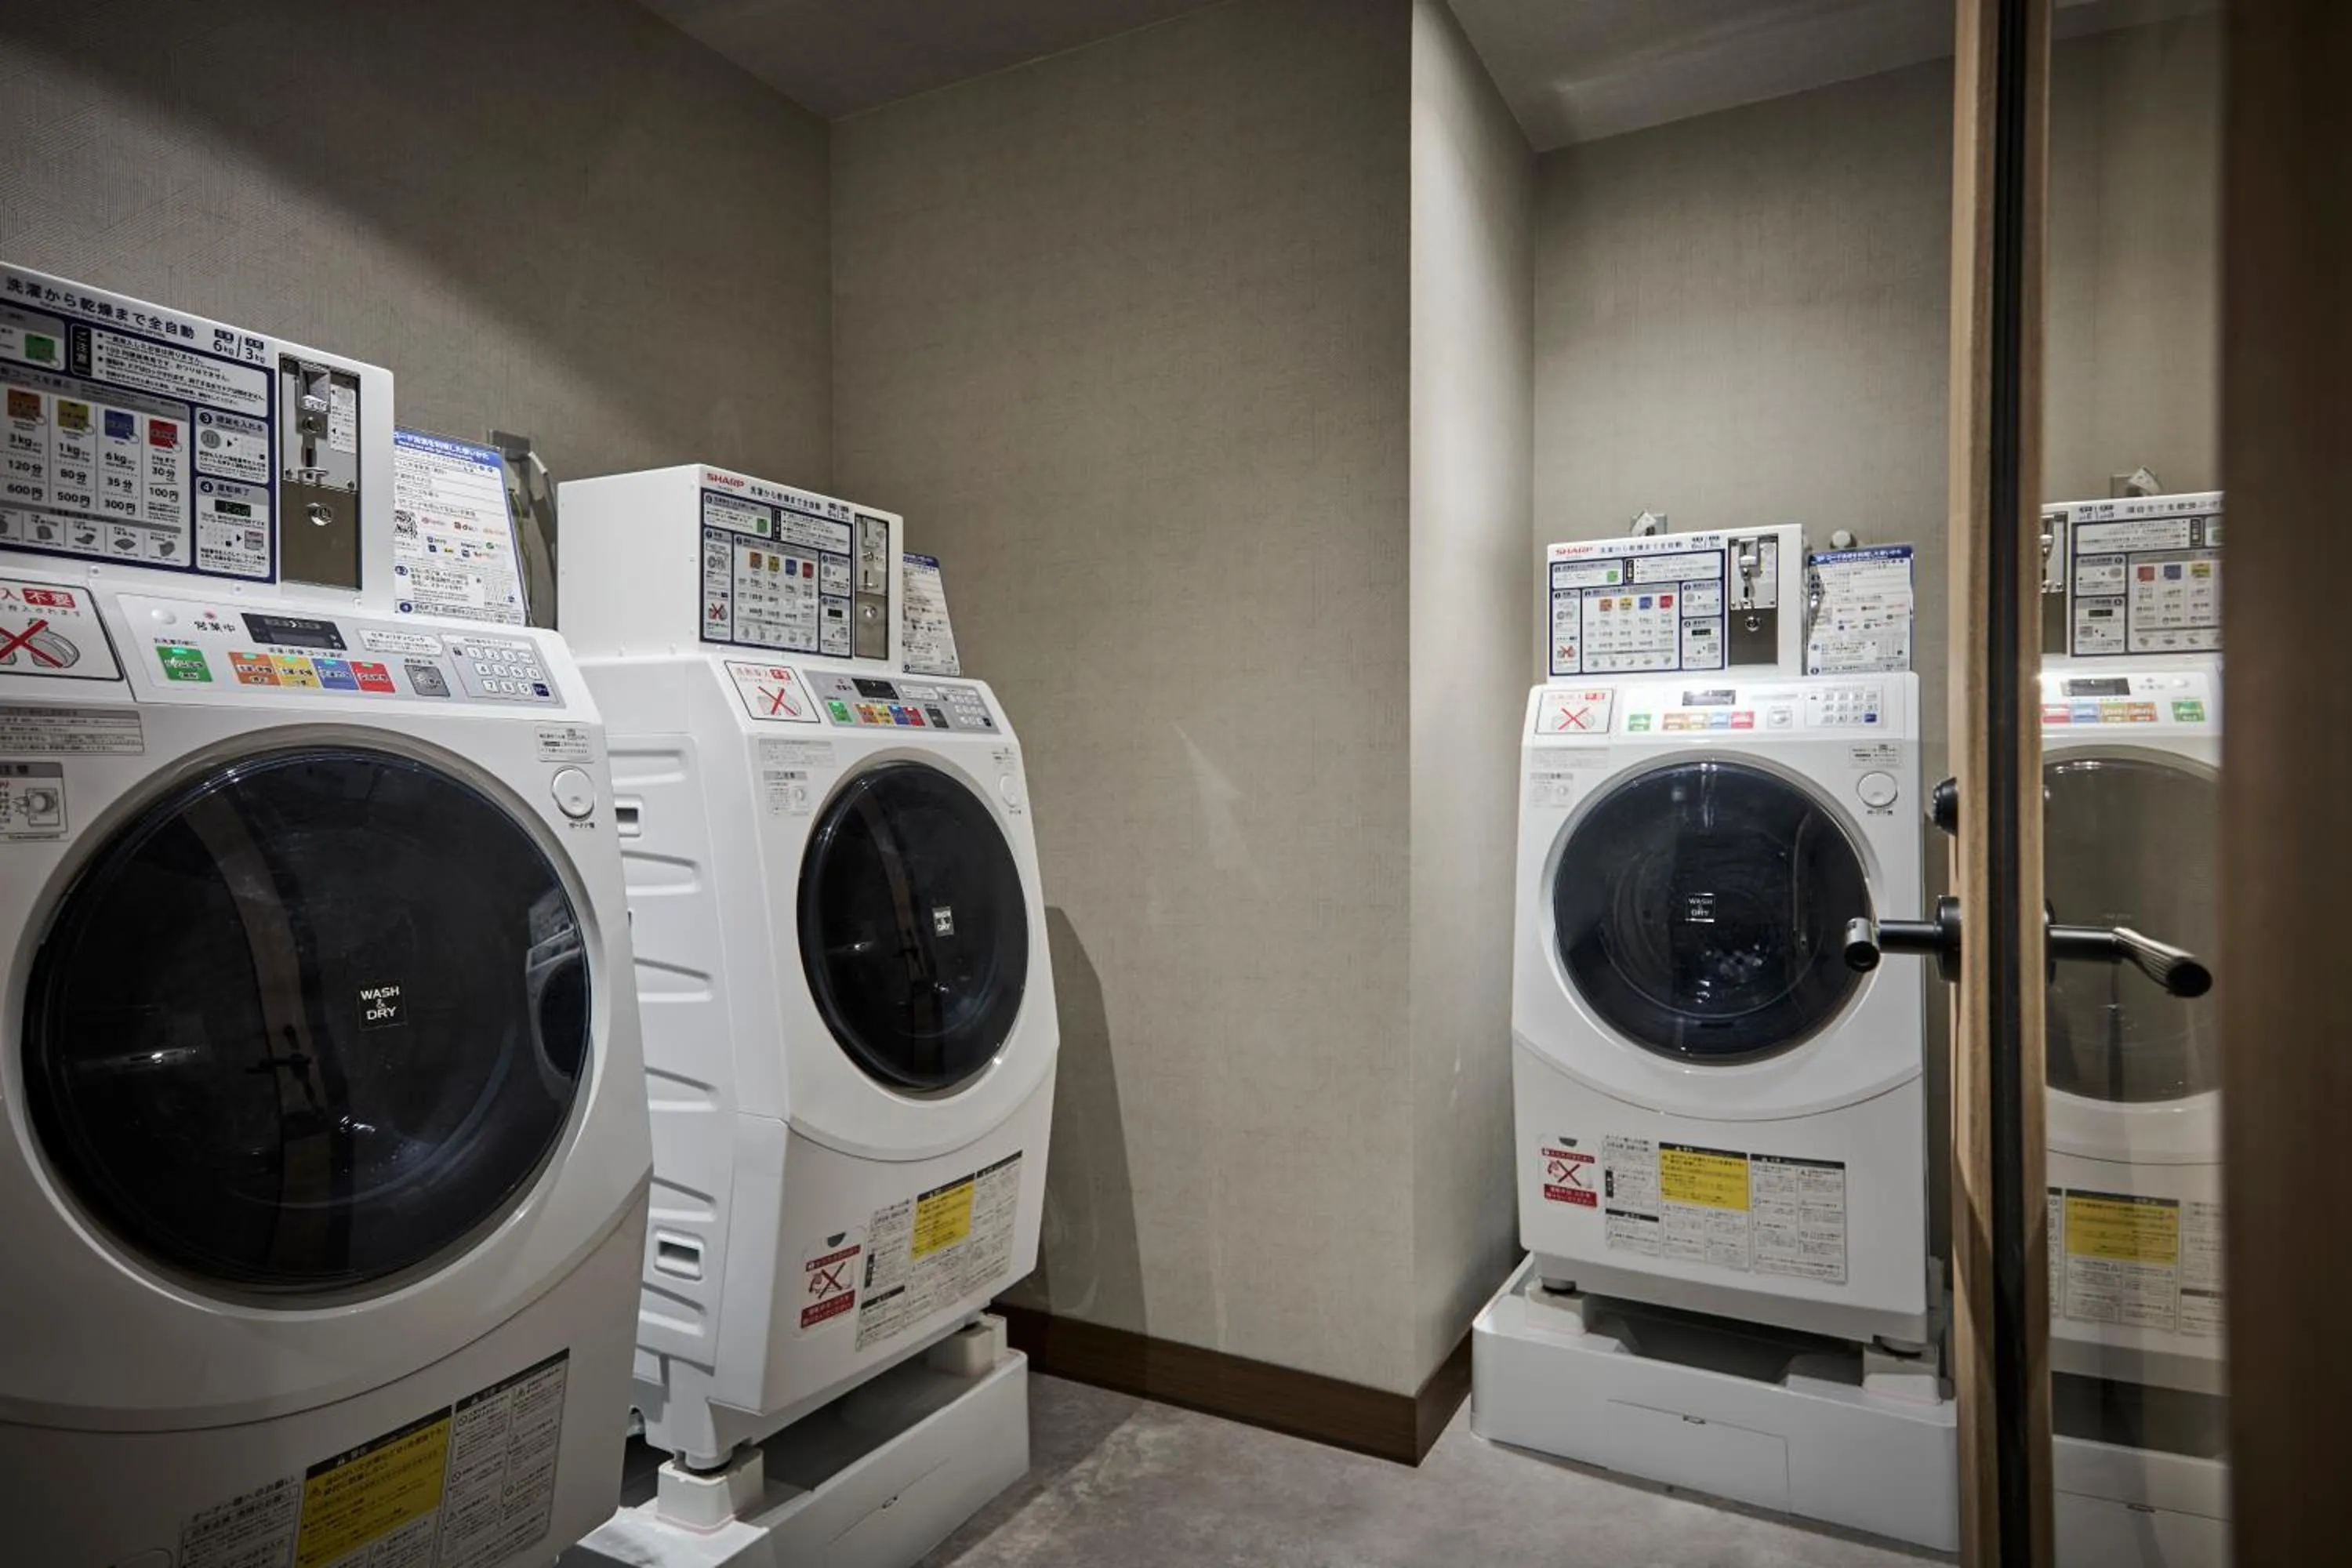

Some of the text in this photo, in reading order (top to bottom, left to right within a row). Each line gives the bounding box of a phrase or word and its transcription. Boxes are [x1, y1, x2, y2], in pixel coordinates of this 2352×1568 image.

[6, 276, 195, 340] 洗濯から乾燥まで全自動
[706, 473, 745, 488] SHARP
[58, 492, 90, 506] 500円
[149, 487, 179, 502] 100円
[361, 985, 401, 1000] WASH
[366, 1006, 397, 1020] DRY
